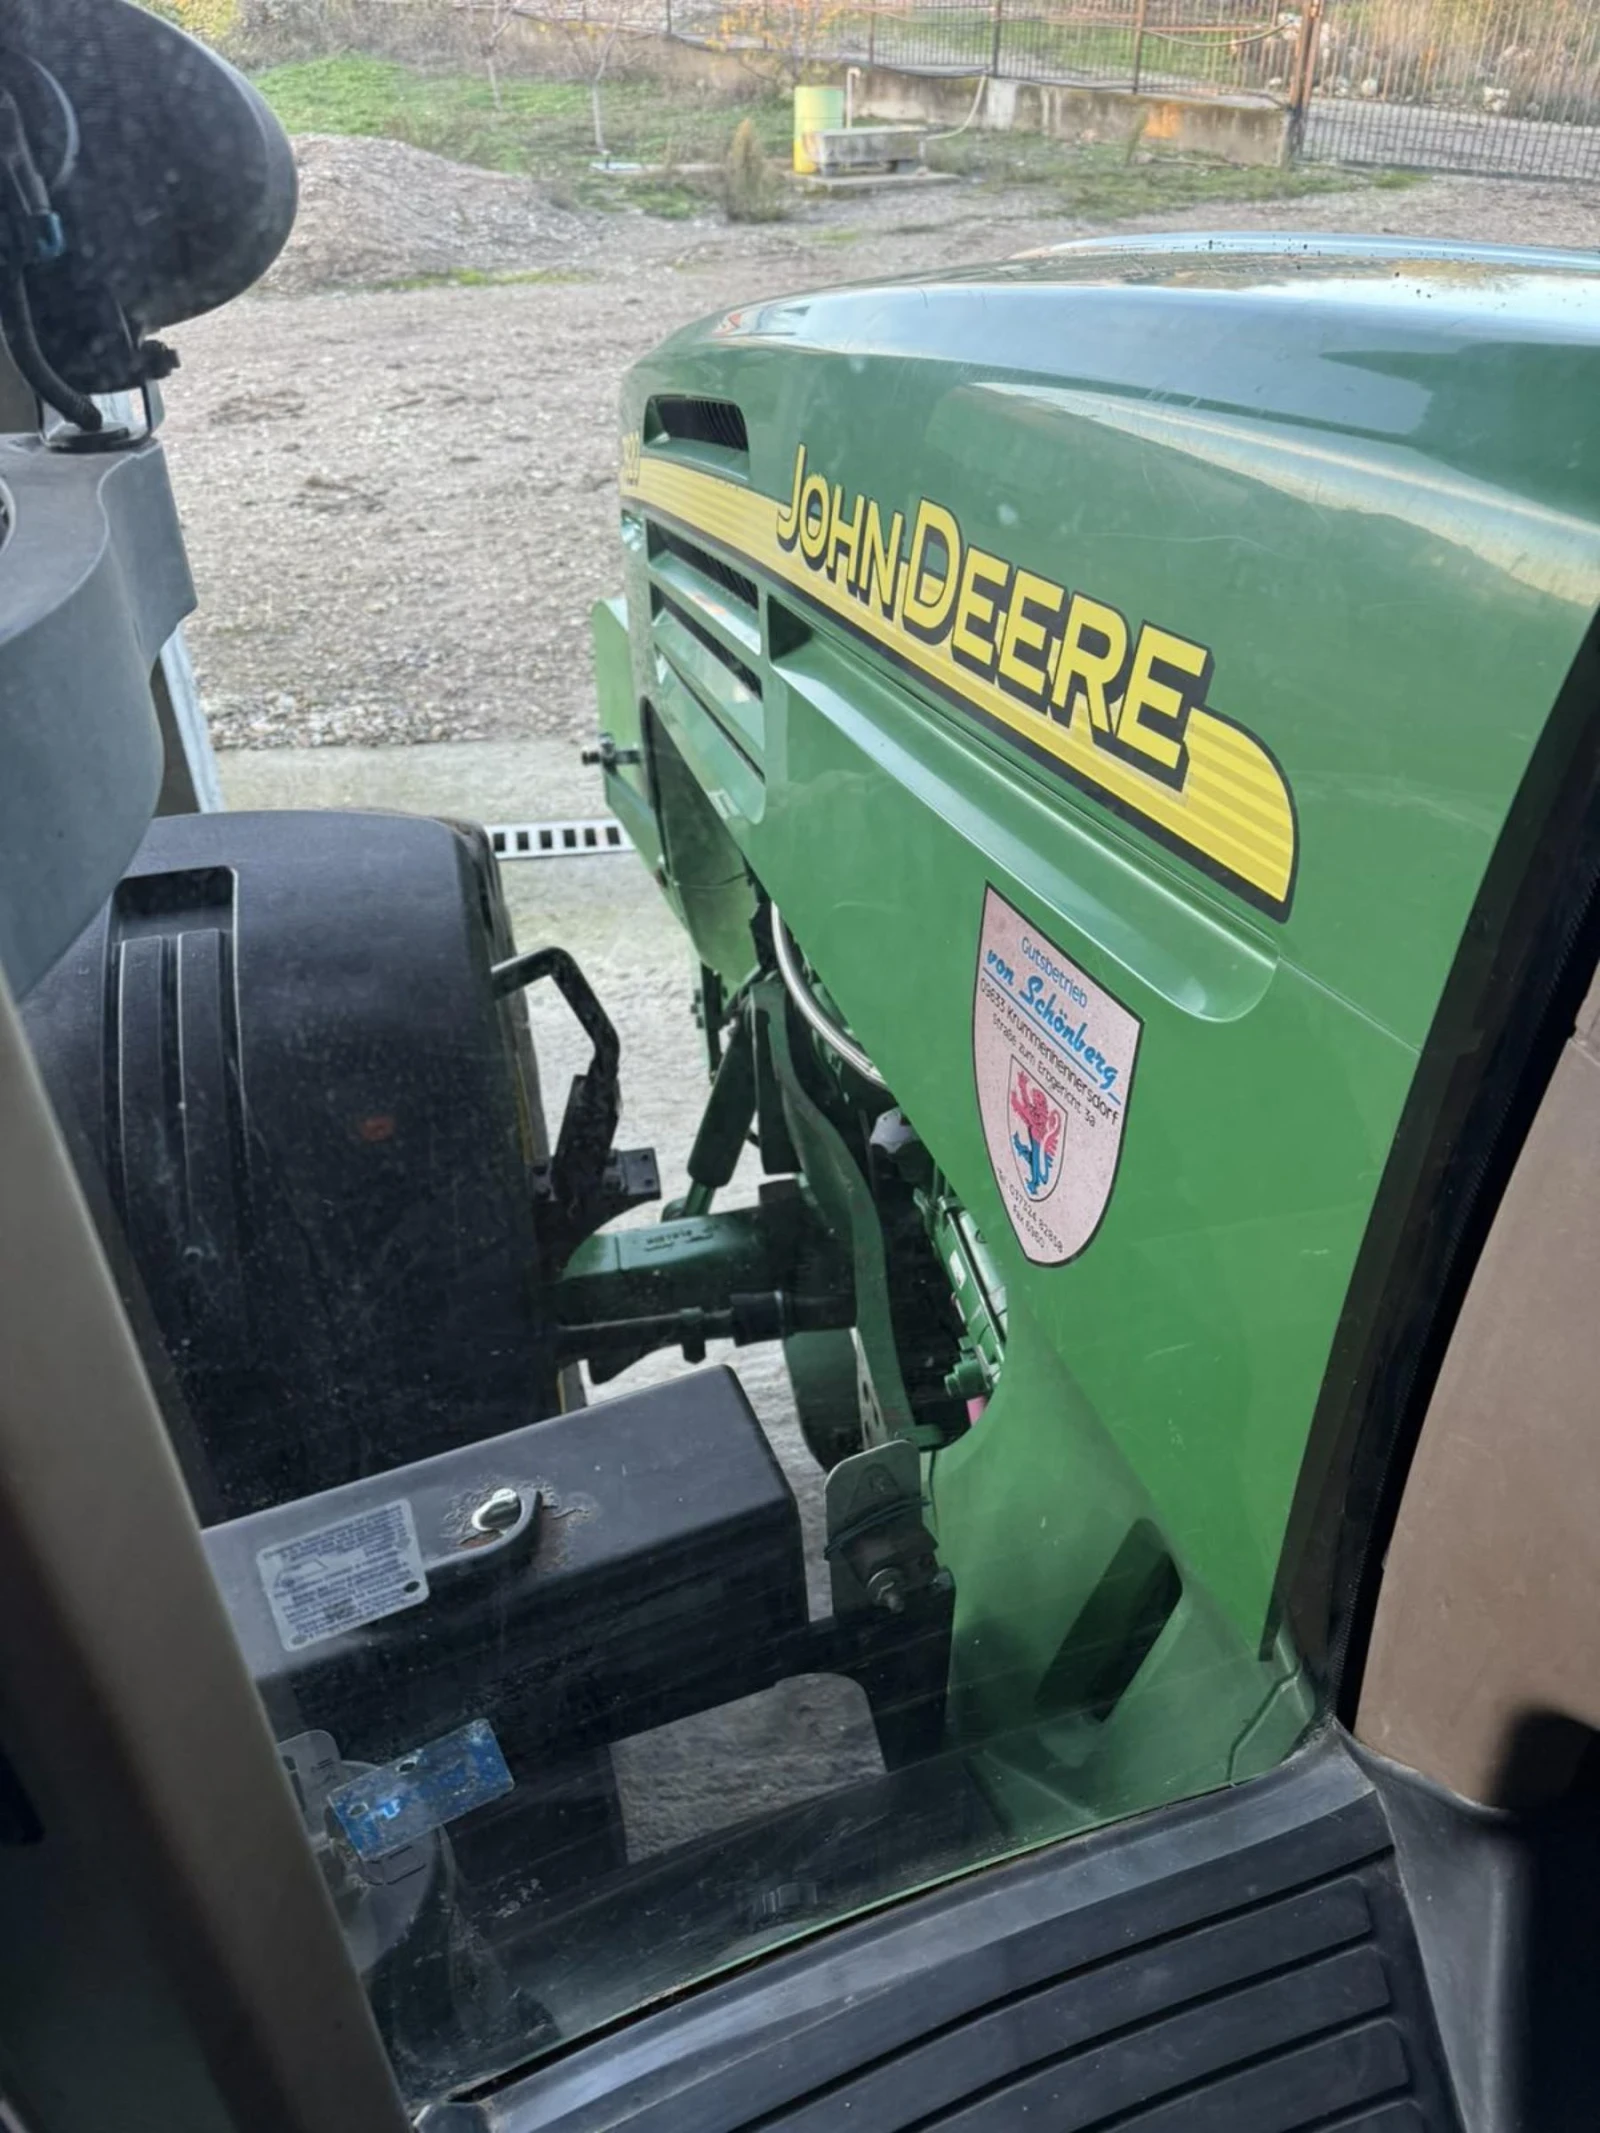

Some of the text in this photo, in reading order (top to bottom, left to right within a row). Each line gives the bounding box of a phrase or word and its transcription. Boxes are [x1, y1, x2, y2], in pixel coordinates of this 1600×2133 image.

[776, 443, 1213, 784] JOHN DEERE
[986, 949, 1119, 1090] von Schönberg
[1021, 936, 1088, 1008] Gutsbetrieb
